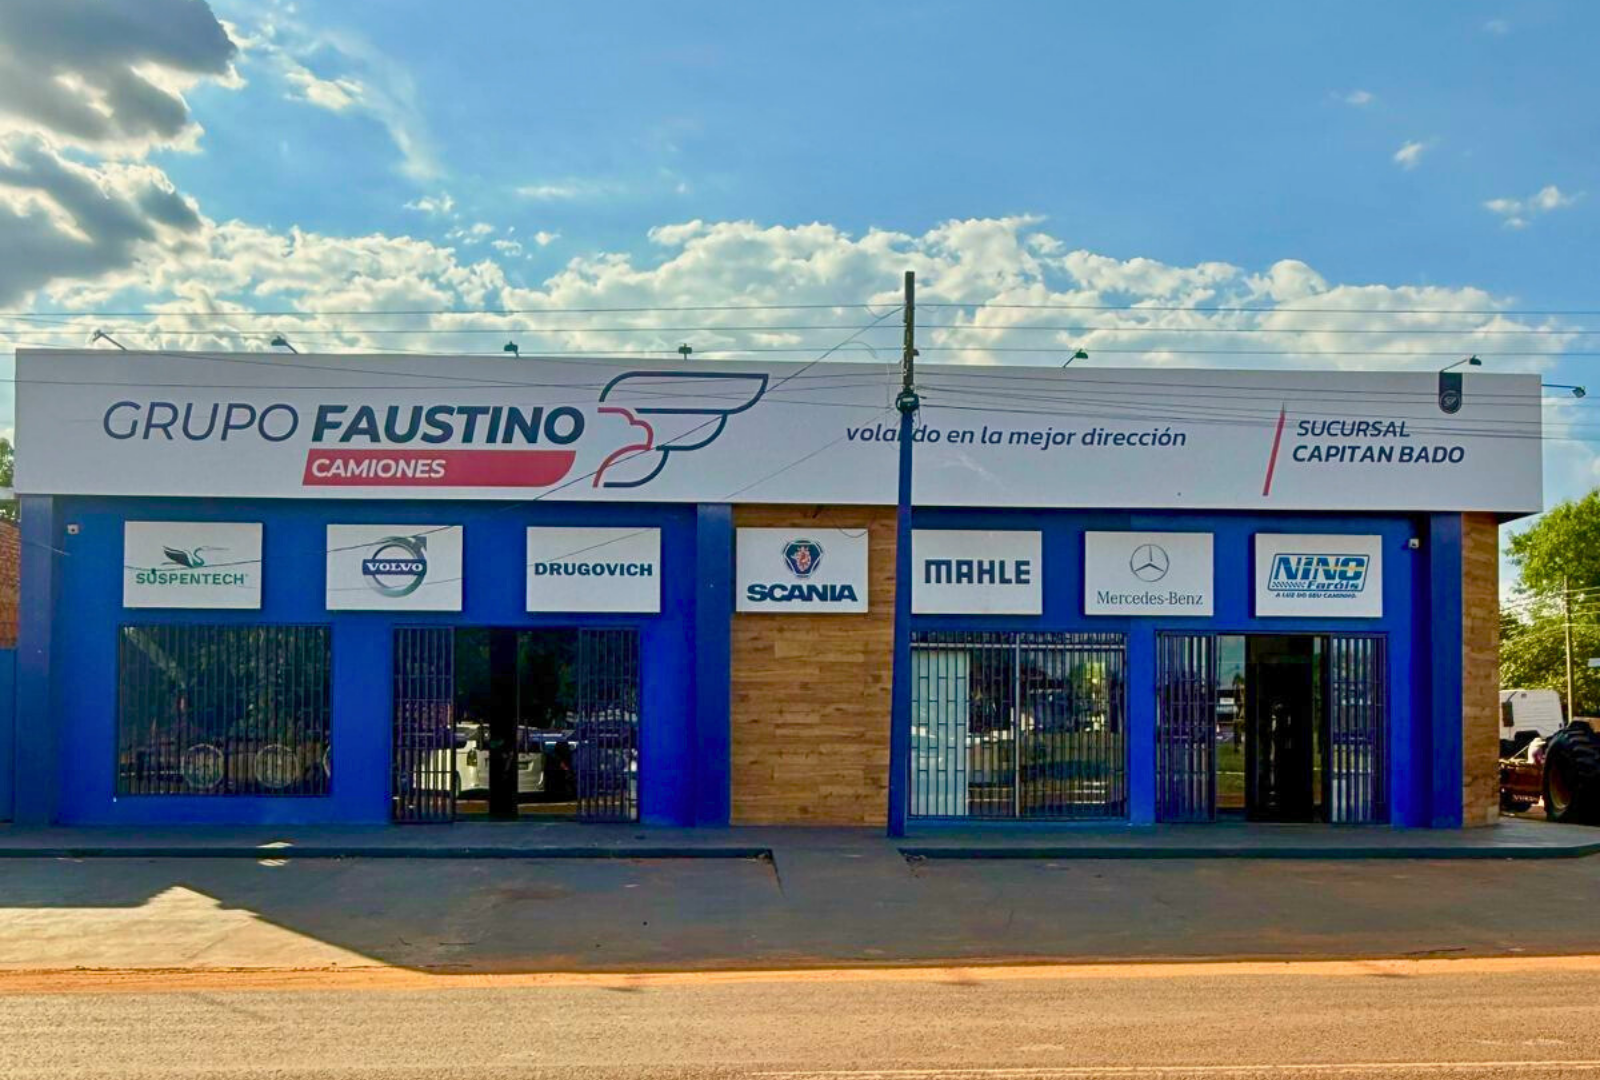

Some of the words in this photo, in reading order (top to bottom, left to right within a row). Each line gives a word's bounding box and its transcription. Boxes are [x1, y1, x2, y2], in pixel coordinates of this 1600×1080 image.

[103, 400, 299, 441] GRUPO
[311, 404, 585, 444] FAUSTINO
[1297, 420, 1411, 437] SUCURSAL
[847, 423, 941, 443] volado
[946, 429, 975, 444] en
[981, 426, 1003, 444] la
[1008, 427, 1076, 450] mejor
[1081, 427, 1186, 446] dirección
[1292, 445, 1394, 462] CAPITAN
[1398, 446, 1465, 463] BADO
[311, 458, 446, 478] CAMIONES
[366, 562, 423, 572] VOLVO
[534, 562, 653, 577] DRUGOVICH
[924, 560, 1030, 584] MAHLE
[136, 573, 244, 585] SUSPENTECH
[746, 583, 858, 602] SCANIA
[1096, 590, 1204, 606] Mercedes-Benz
